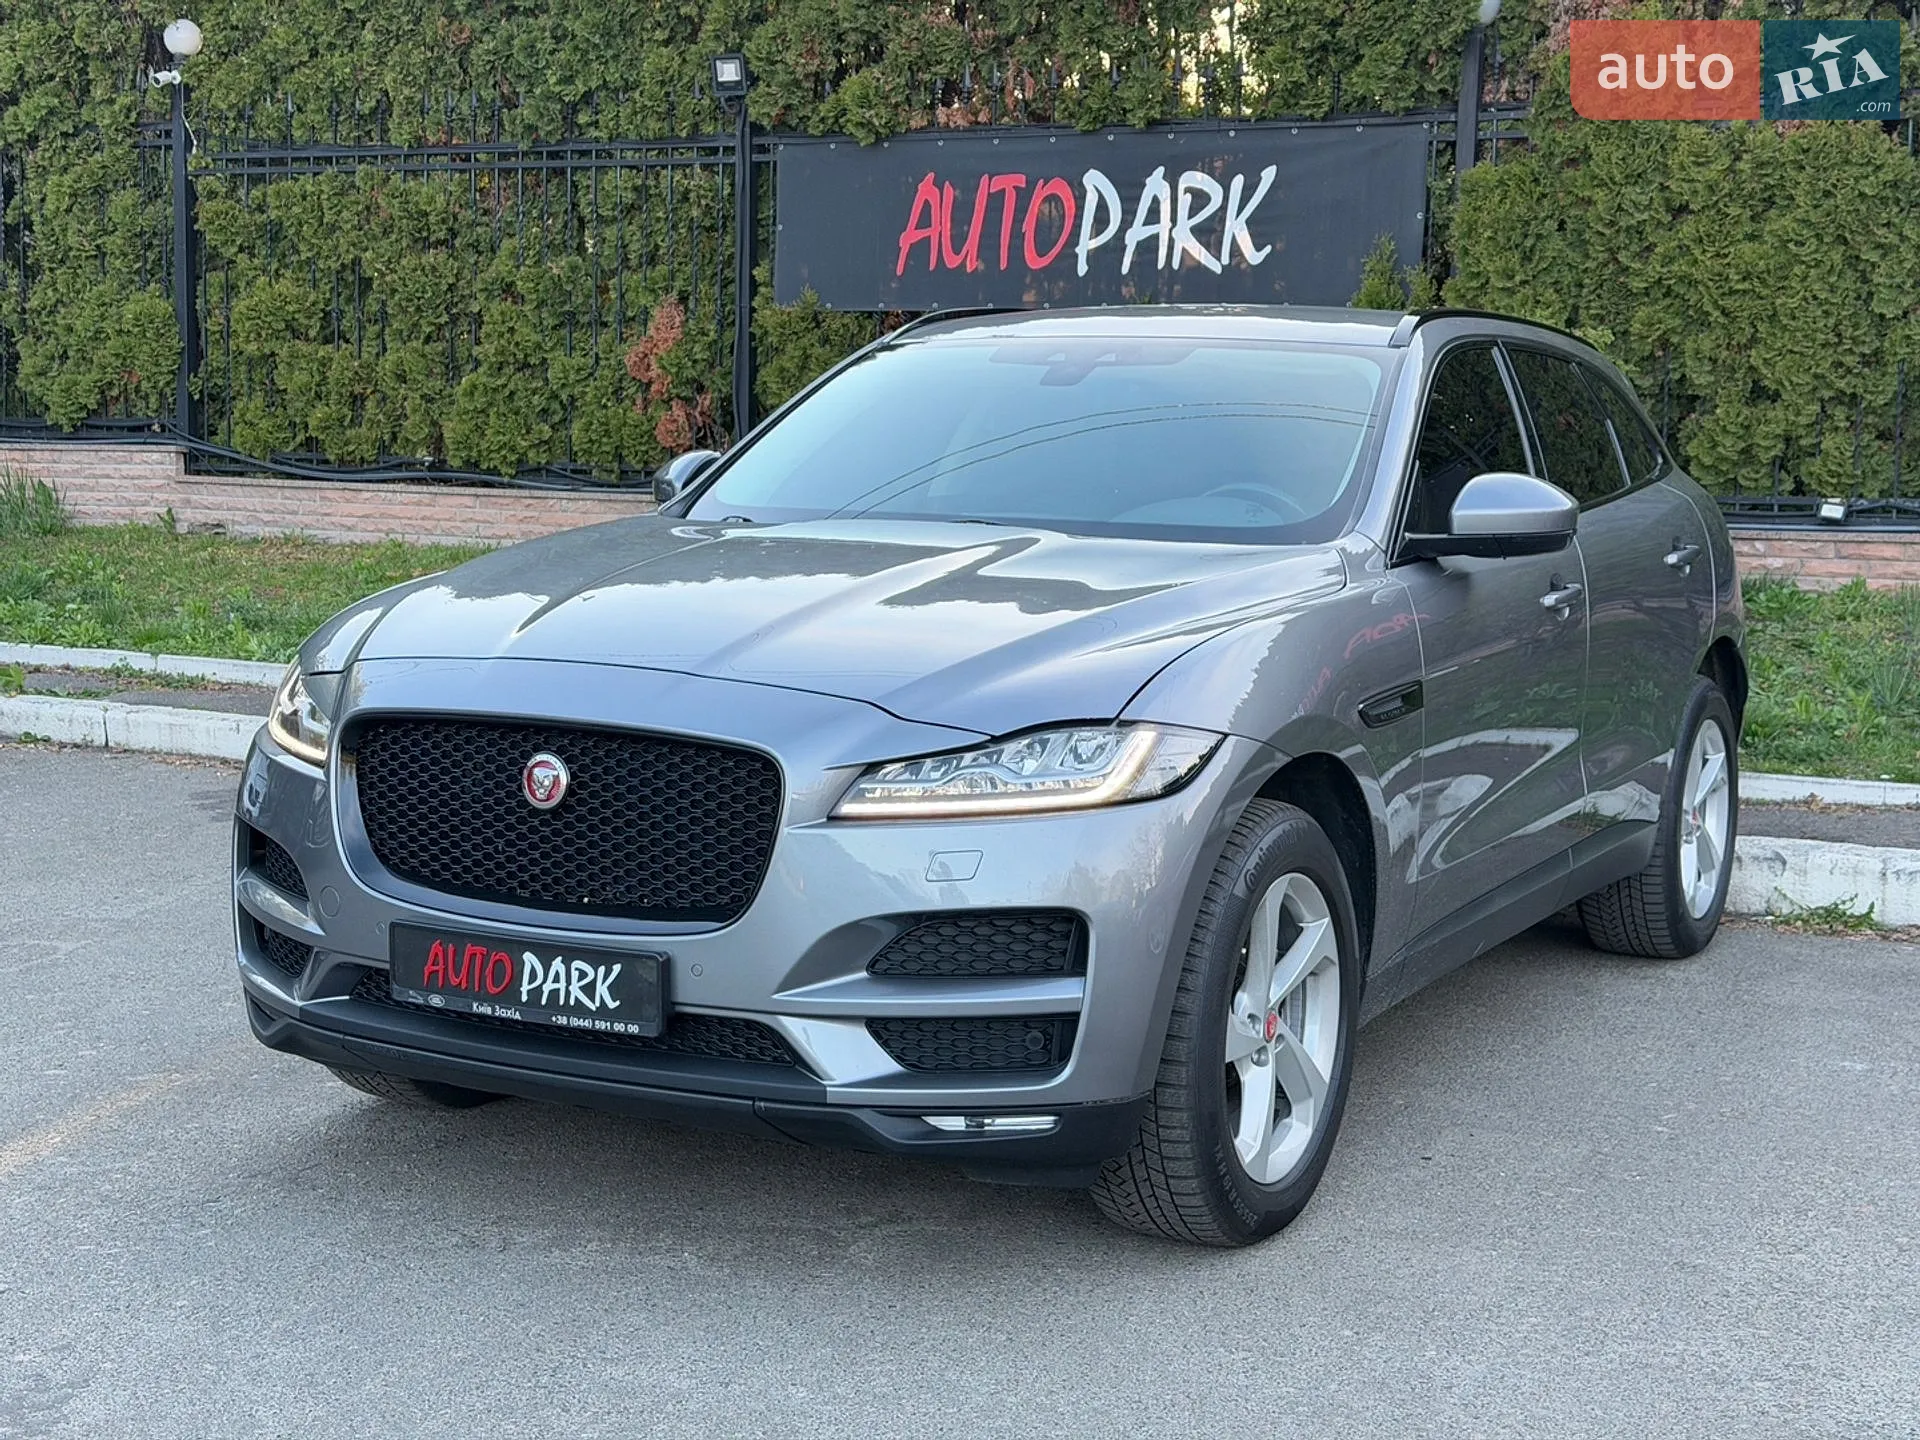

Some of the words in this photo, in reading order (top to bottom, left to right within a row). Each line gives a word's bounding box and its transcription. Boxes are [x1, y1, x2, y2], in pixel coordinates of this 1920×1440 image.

[551, 1015, 568, 1025] +38
[569, 1015, 593, 1029] (044)
[594, 1020, 611, 1031] 591
[613, 1022, 626, 1032] 00
[627, 1024, 640, 1034] 00
